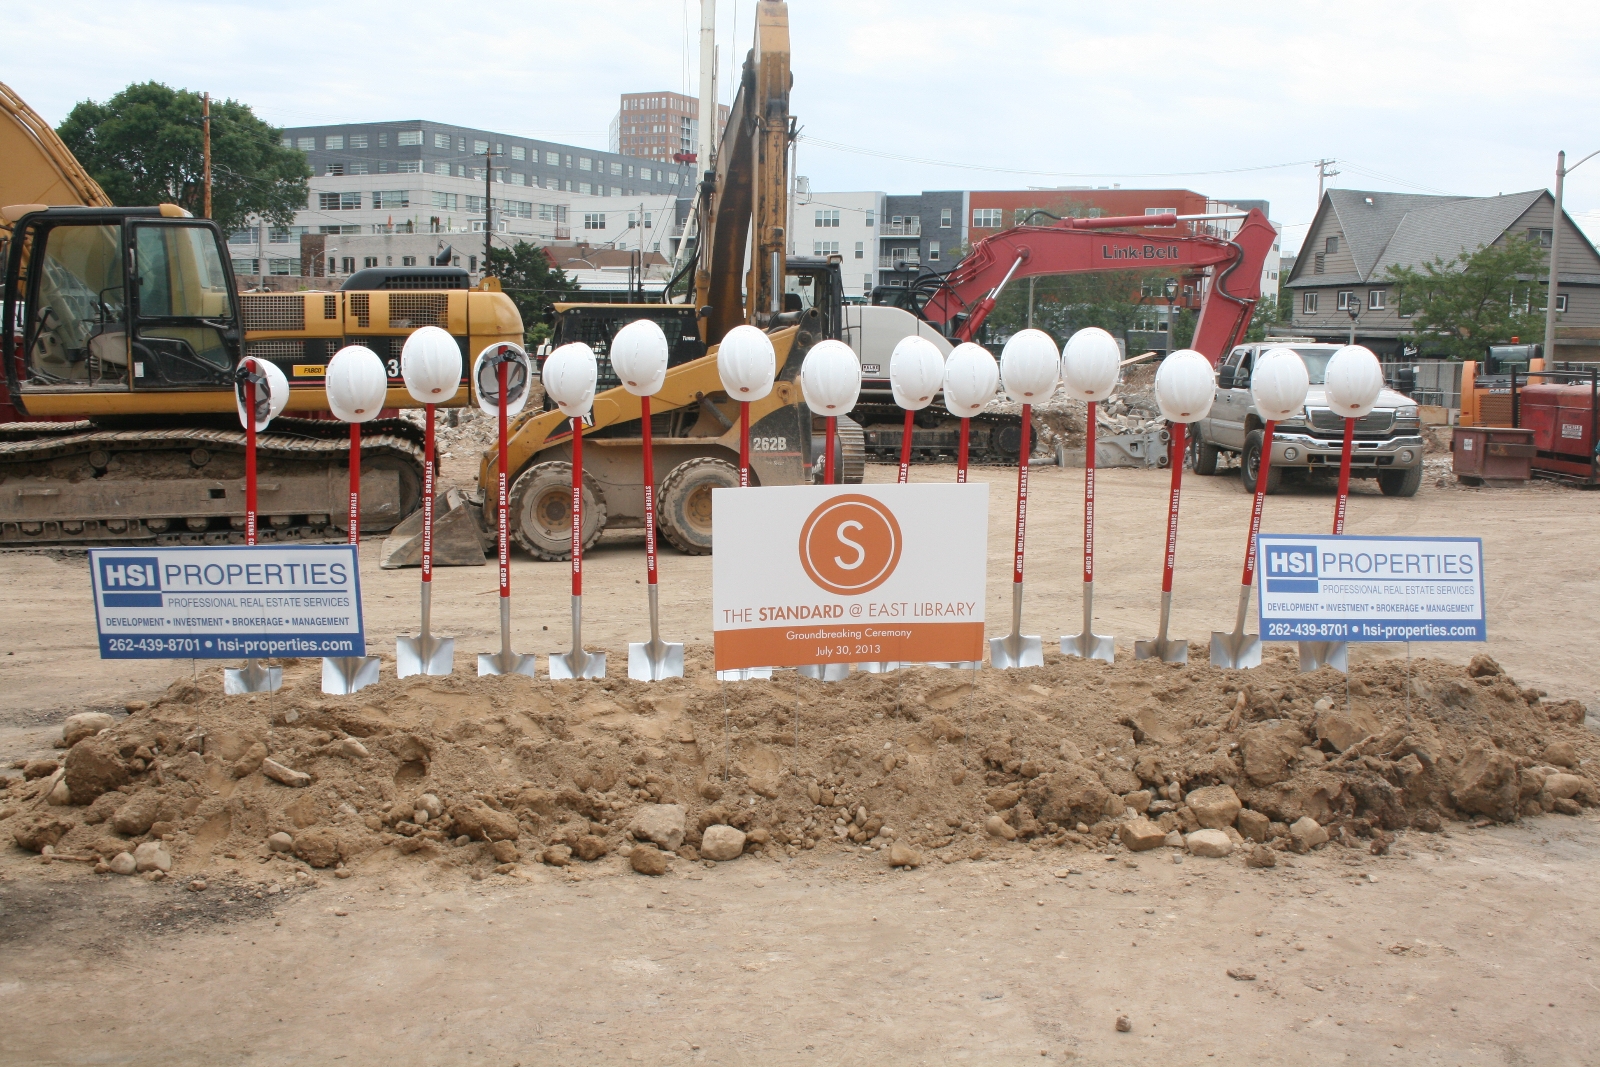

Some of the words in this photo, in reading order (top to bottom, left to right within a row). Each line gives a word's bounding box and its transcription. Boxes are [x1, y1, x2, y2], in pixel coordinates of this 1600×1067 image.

[753, 436, 787, 451] 262B
[1270, 551, 1313, 573] HSI
[1322, 552, 1474, 575] PROPERTIES
[105, 564, 156, 587] HSI
[164, 562, 348, 586] PROPERTIES
[1322, 584, 1383, 595] PROFESSIONAL
[1383, 585, 1404, 595] REAL
[1405, 585, 1435, 595] ESTATE
[1436, 585, 1475, 595] SERVICES
[168, 597, 239, 608] PROFESSIONAL
[240, 597, 264, 608] REAL
[265, 597, 302, 607] ESTATE
[303, 597, 350, 607] SERVICES
[1267, 602, 1319, 612] DEVELOPMENT
[1325, 603, 1369, 612] INVESTMENT
[1376, 603, 1420, 613] BROKERAGE
[1426, 604, 1474, 613] MANAGEMENT
[722, 607, 753, 624] THE
[758, 604, 844, 622] STANDARD
[848, 603, 863, 618] @
[868, 602, 909, 617] EAST
[913, 601, 976, 617] LIBRARY
[105, 617, 165, 627] DEVELOPMENT
[173, 617, 224, 627] INVESTMENT
[232, 617, 284, 626] BROKERAGE
[292, 617, 350, 626] MANAGEMENT
[786, 628, 862, 640] Groundbreaking
[864, 627, 912, 639] Ceremony
[1268, 623, 1348, 636] 262-439-8701
[1362, 623, 1476, 639] hsi-properties.com
[108, 638, 200, 652] 262-439-8701
[217, 637, 353, 655] hsi-properties.com
[815, 645, 833, 657] July
[836, 645, 852, 655] 30,
[855, 644, 881, 654] 2013
